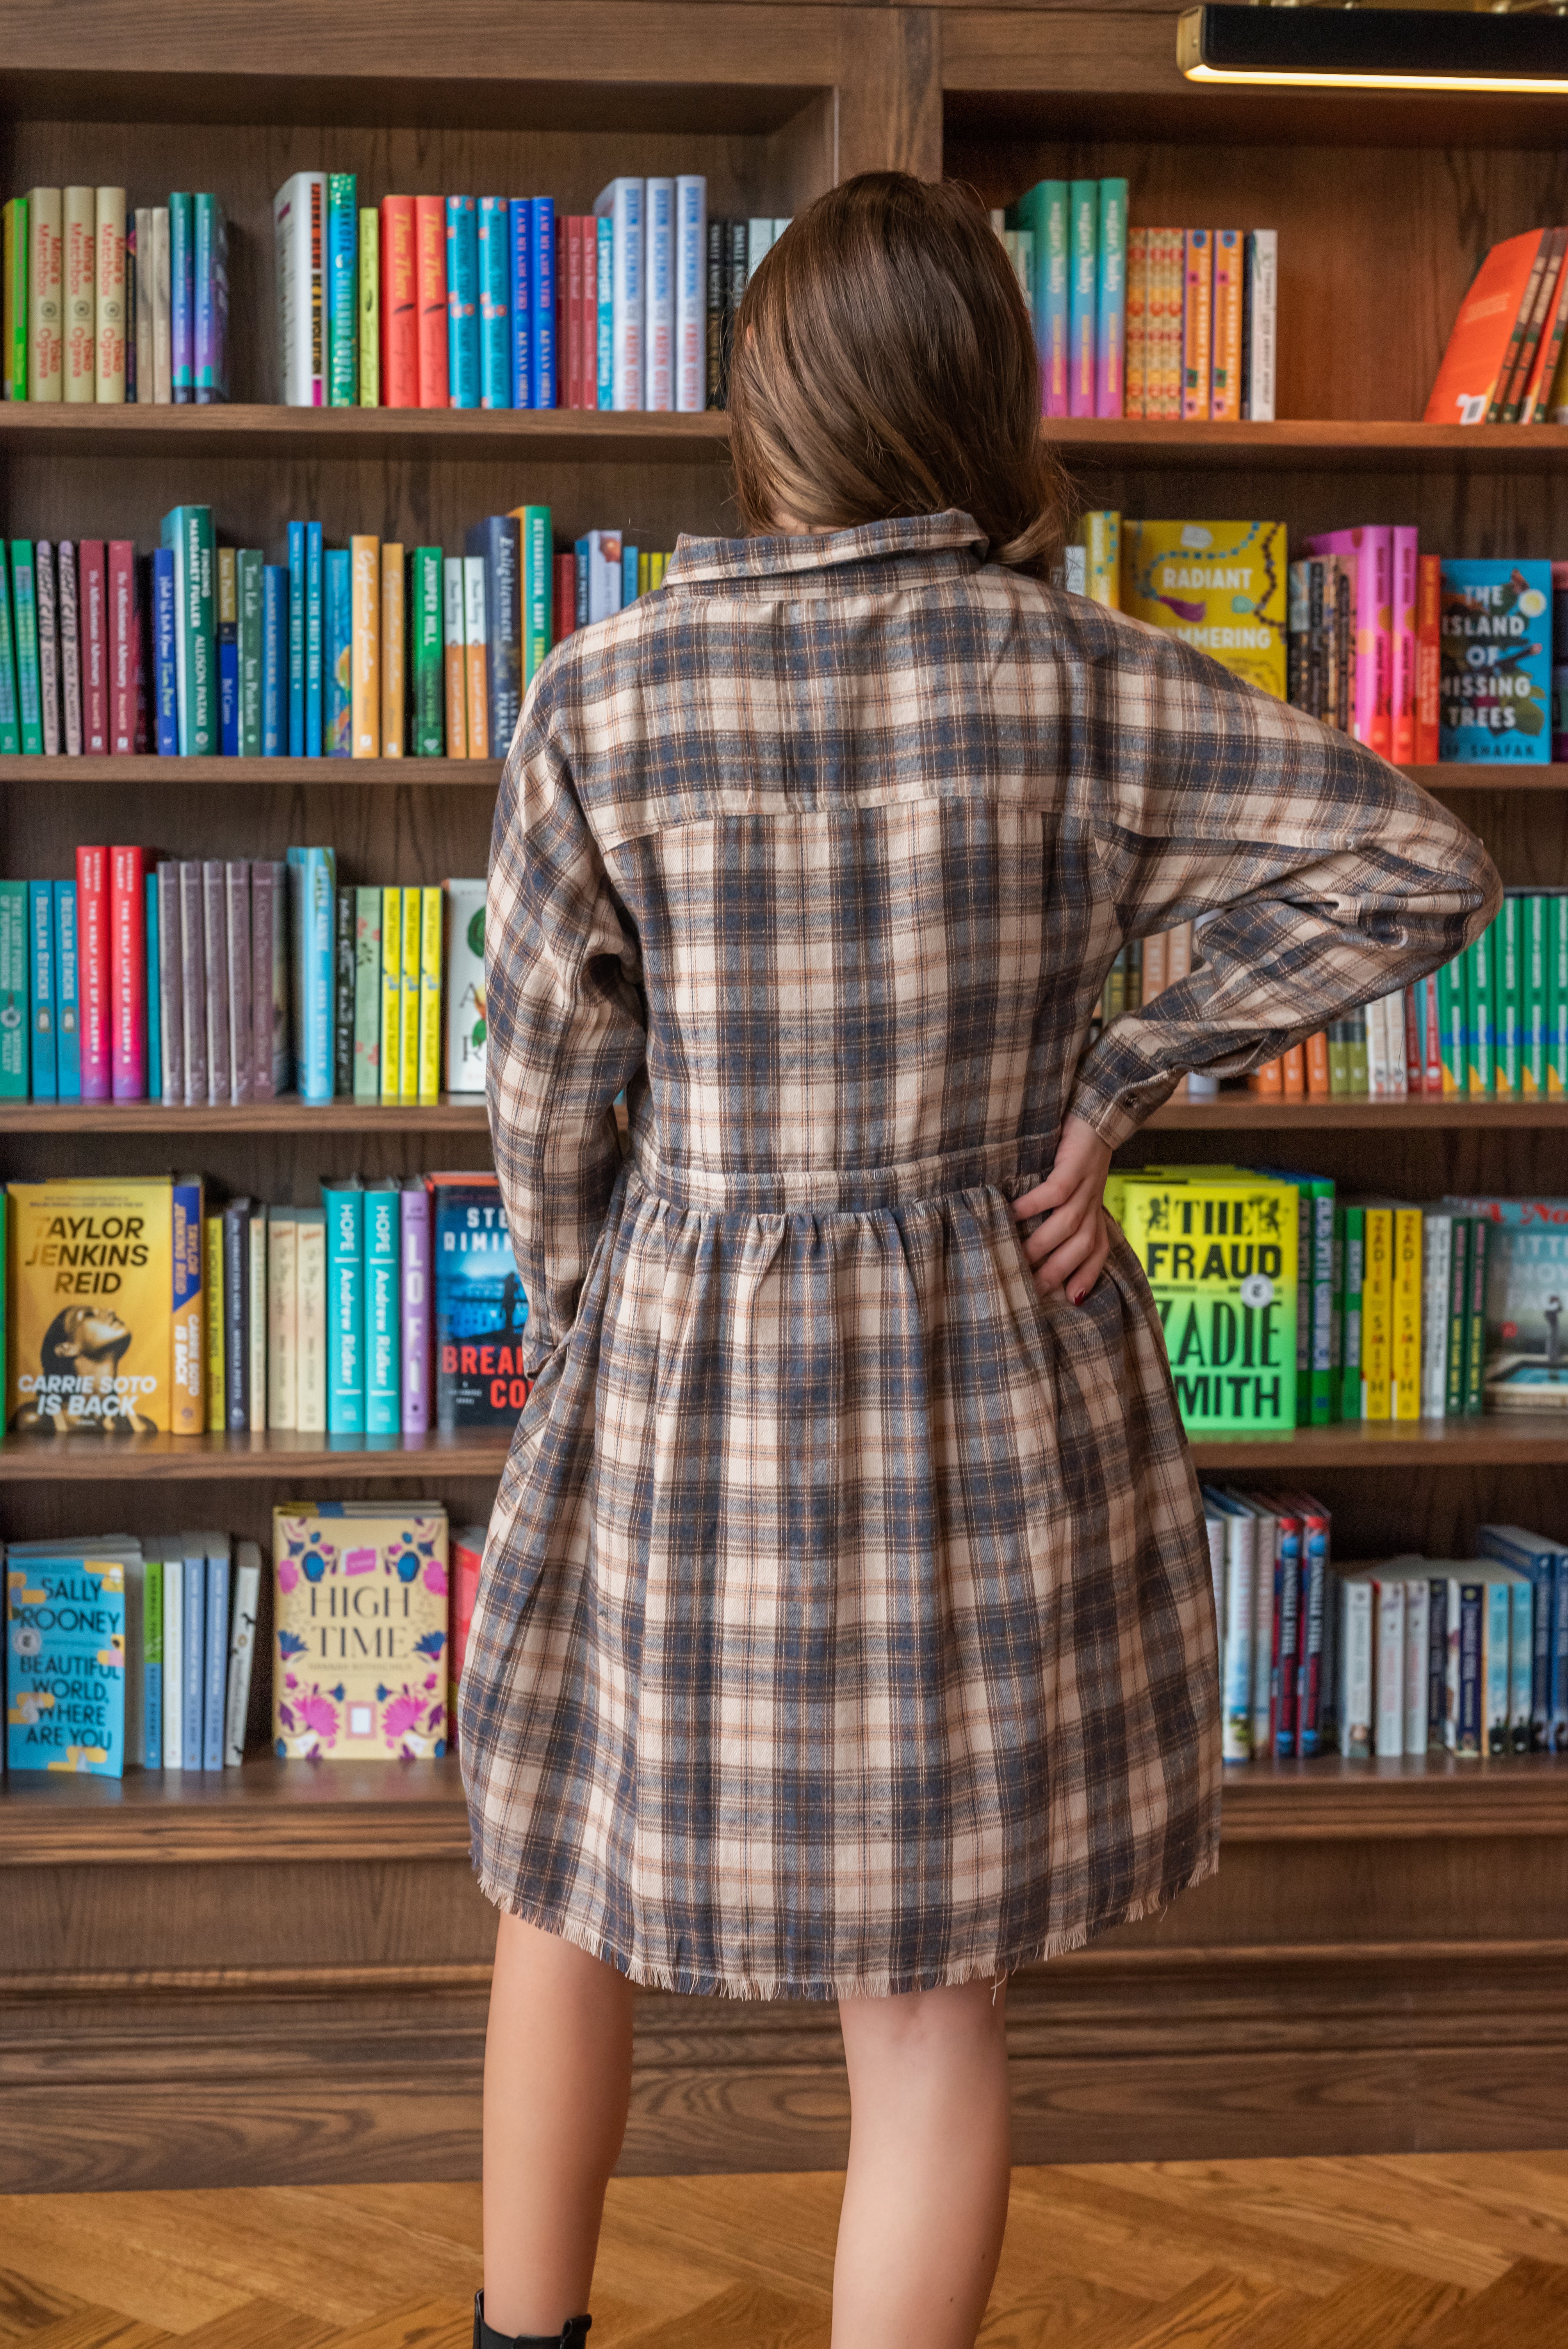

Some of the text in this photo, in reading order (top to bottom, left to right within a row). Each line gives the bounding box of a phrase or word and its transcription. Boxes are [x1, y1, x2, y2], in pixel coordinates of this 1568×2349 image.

[39, 224, 50, 296] Matchbox
[51, 237, 62, 284] Mina's
[71, 223, 82, 295] Matchbox
[83, 235, 94, 283] Mina's
[102, 223, 114, 296] Matchbox
[114, 237, 126, 284] Mina's
[394, 214, 411, 299] There There
[424, 214, 440, 299] There There
[36, 328, 52, 378] Ogawa
[51, 339, 62, 372] Yoko
[69, 327, 84, 378] Ogawa
[83, 338, 94, 372] Yoko
[100, 328, 115, 378] Ogawa
[114, 339, 125, 373] Yoko
[189, 519, 201, 628] MARGARET FULLER
[222, 556, 232, 618] Ann Patchett
[246, 563, 258, 618] Tom Lake
[497, 536, 515, 642] Enlightenment
[532, 518, 545, 630] DETRANSITION, BABY
[1163, 567, 1253, 589] RADIANT
[424, 556, 437, 646] JUNIPER HILL
[1464, 585, 1503, 605] THE
[1167, 627, 1270, 649] MMERING
[1442, 615, 1525, 636] ISLAND
[195, 634, 207, 683] ALLISON
[1466, 646, 1499, 666] OF
[246, 656, 258, 725] Ann Patchett
[1441, 675, 1531, 697] MISSING
[1448, 706, 1516, 728] TREES
[36, 896, 50, 999] BEDLAM STACKS
[61, 896, 75, 999] BEDLAM STACKS
[36, 1217, 145, 1240] TAYLOR
[340, 1204, 355, 1251] HOPE
[376, 1205, 390, 1253] HOPE
[467, 1207, 509, 1229] STE
[1175, 1198, 1253, 1237] THE
[25, 1244, 149, 1267] JENKINS
[175, 1203, 187, 1295] JENKINS REID
[188, 1224, 199, 1275] TAYLOR
[444, 1232, 512, 1252] RIMI
[1147, 1243, 1282, 1281] FRAUD
[53, 1271, 122, 1294] REID
[340, 1268, 356, 1386] Andrew Ridker
[375, 1269, 391, 1386] Andrew Ridker
[175, 1325, 187, 1386] IS BACK
[189, 1314, 199, 1397] CARRIE SOTO
[442, 1346, 523, 1375] BREA
[18, 1375, 157, 1394] CARRIE SOTO
[490, 1379, 533, 1409] CO
[1174, 1375, 1281, 1417] MITH
[37, 1395, 138, 1417] IS BACK
[41, 1577, 103, 1602] SALLY
[310, 1586, 409, 1619] HIGH
[20, 1608, 120, 1634] ROONEY
[311, 1625, 409, 1658] TIME
[20, 1654, 121, 1680] BEAUTIFUL
[32, 1677, 110, 1704] WORLD,
[37, 1704, 106, 1726] WHERE
[25, 1725, 113, 1751] ARE YOU
